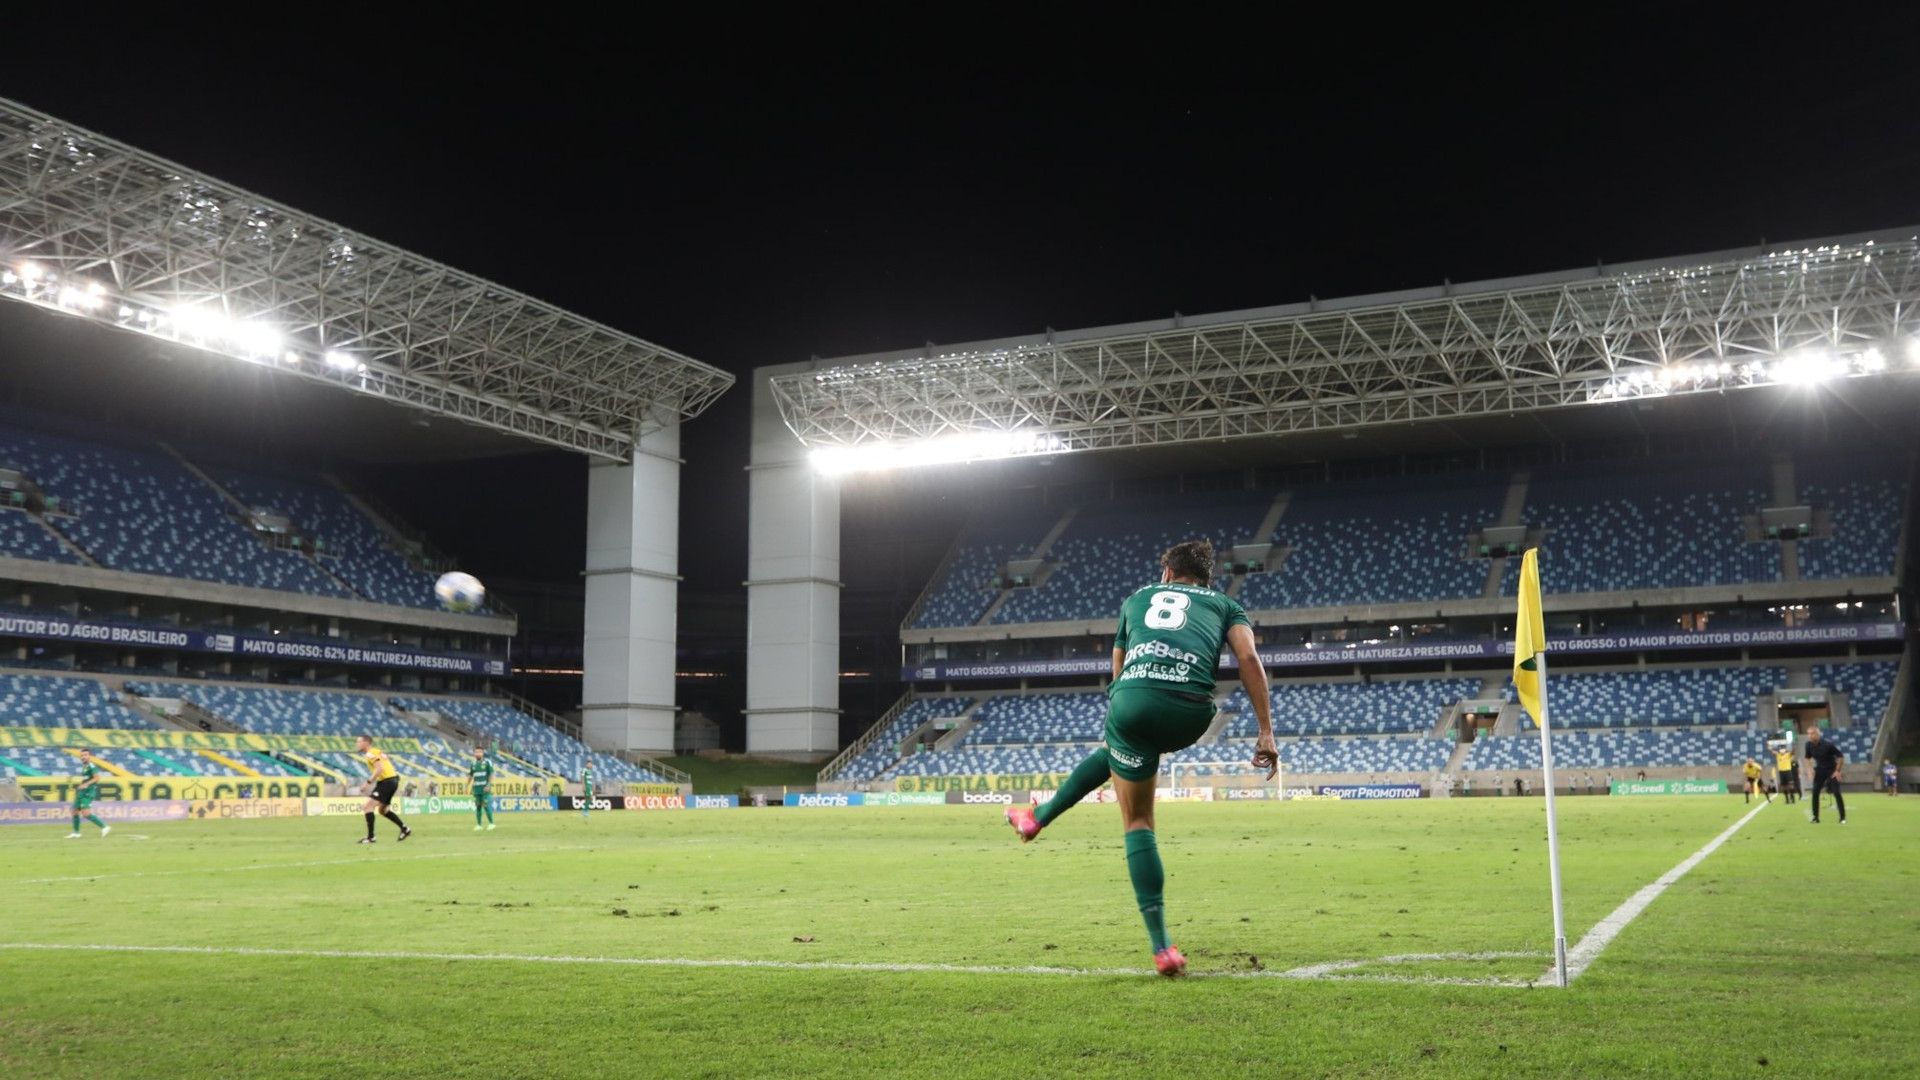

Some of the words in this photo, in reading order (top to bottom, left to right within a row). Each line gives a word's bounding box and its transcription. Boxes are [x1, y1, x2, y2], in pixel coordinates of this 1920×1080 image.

[1144, 590, 1191, 631] 8
[49, 622, 69, 636] DO
[71, 624, 110, 640] AGRO
[111, 628, 188, 646] BRASILEIRO
[1545, 640, 1567, 651] ATO
[1568, 638, 1617, 650] GROSSO:
[1619, 637, 1628, 647] O
[1629, 635, 1667, 647] MAIOR
[1668, 631, 1731, 645] PRODUTOR
[1733, 631, 1750, 643] DO
[1752, 630, 1784, 642] AGRO
[1787, 627, 1858, 640] BRASILEIRO
[243, 640, 275, 653] MATO
[277, 642, 323, 658] GROSSO:
[324, 646, 346, 660] 62%
[348, 649, 361, 662] DE
[362, 650, 413, 666] NATUREZA
[414, 655, 472, 670] PRESERVADA
[1259, 653, 1272, 663] TO
[1274, 652, 1316, 663] GROSSO:
[1319, 651, 1340, 661] 62%
[1342, 650, 1355, 660] DE
[1357, 647, 1412, 659] NATUREZA
[1413, 643, 1484, 657] PRESERVADA
[946, 667, 970, 677] MATO
[971, 666, 1009, 676] GROSSO:
[1010, 665, 1016, 674] O
[1018, 664, 1047, 674] MAIOR
[1048, 662, 1096, 673] PRODUTOR
[1098, 661, 1111, 671] DO
[1130, 662, 1176, 676] ONHEÇA
[1148, 671, 1189, 683] GROSSO
[491, 782, 528, 795] UIABA
[996, 776, 1066, 792] CUIA
[1631, 784, 1665, 793] Sicredi
[1684, 783, 1719, 793] Sicredi
[799, 793, 848, 807] betcris
[963, 791, 1013, 803] bodog
[1322, 787, 1357, 799] SPORT
[1358, 787, 1420, 799] PROMOTION
[328, 801, 363, 814] merca
[500, 798, 519, 810] CBF
[520, 797, 553, 810] SOCIAL
[624, 795, 645, 809] GOL
[646, 795, 665, 809] GOL
[666, 794, 685, 809] GOL
[93, 804, 128, 819] SSAÍ
